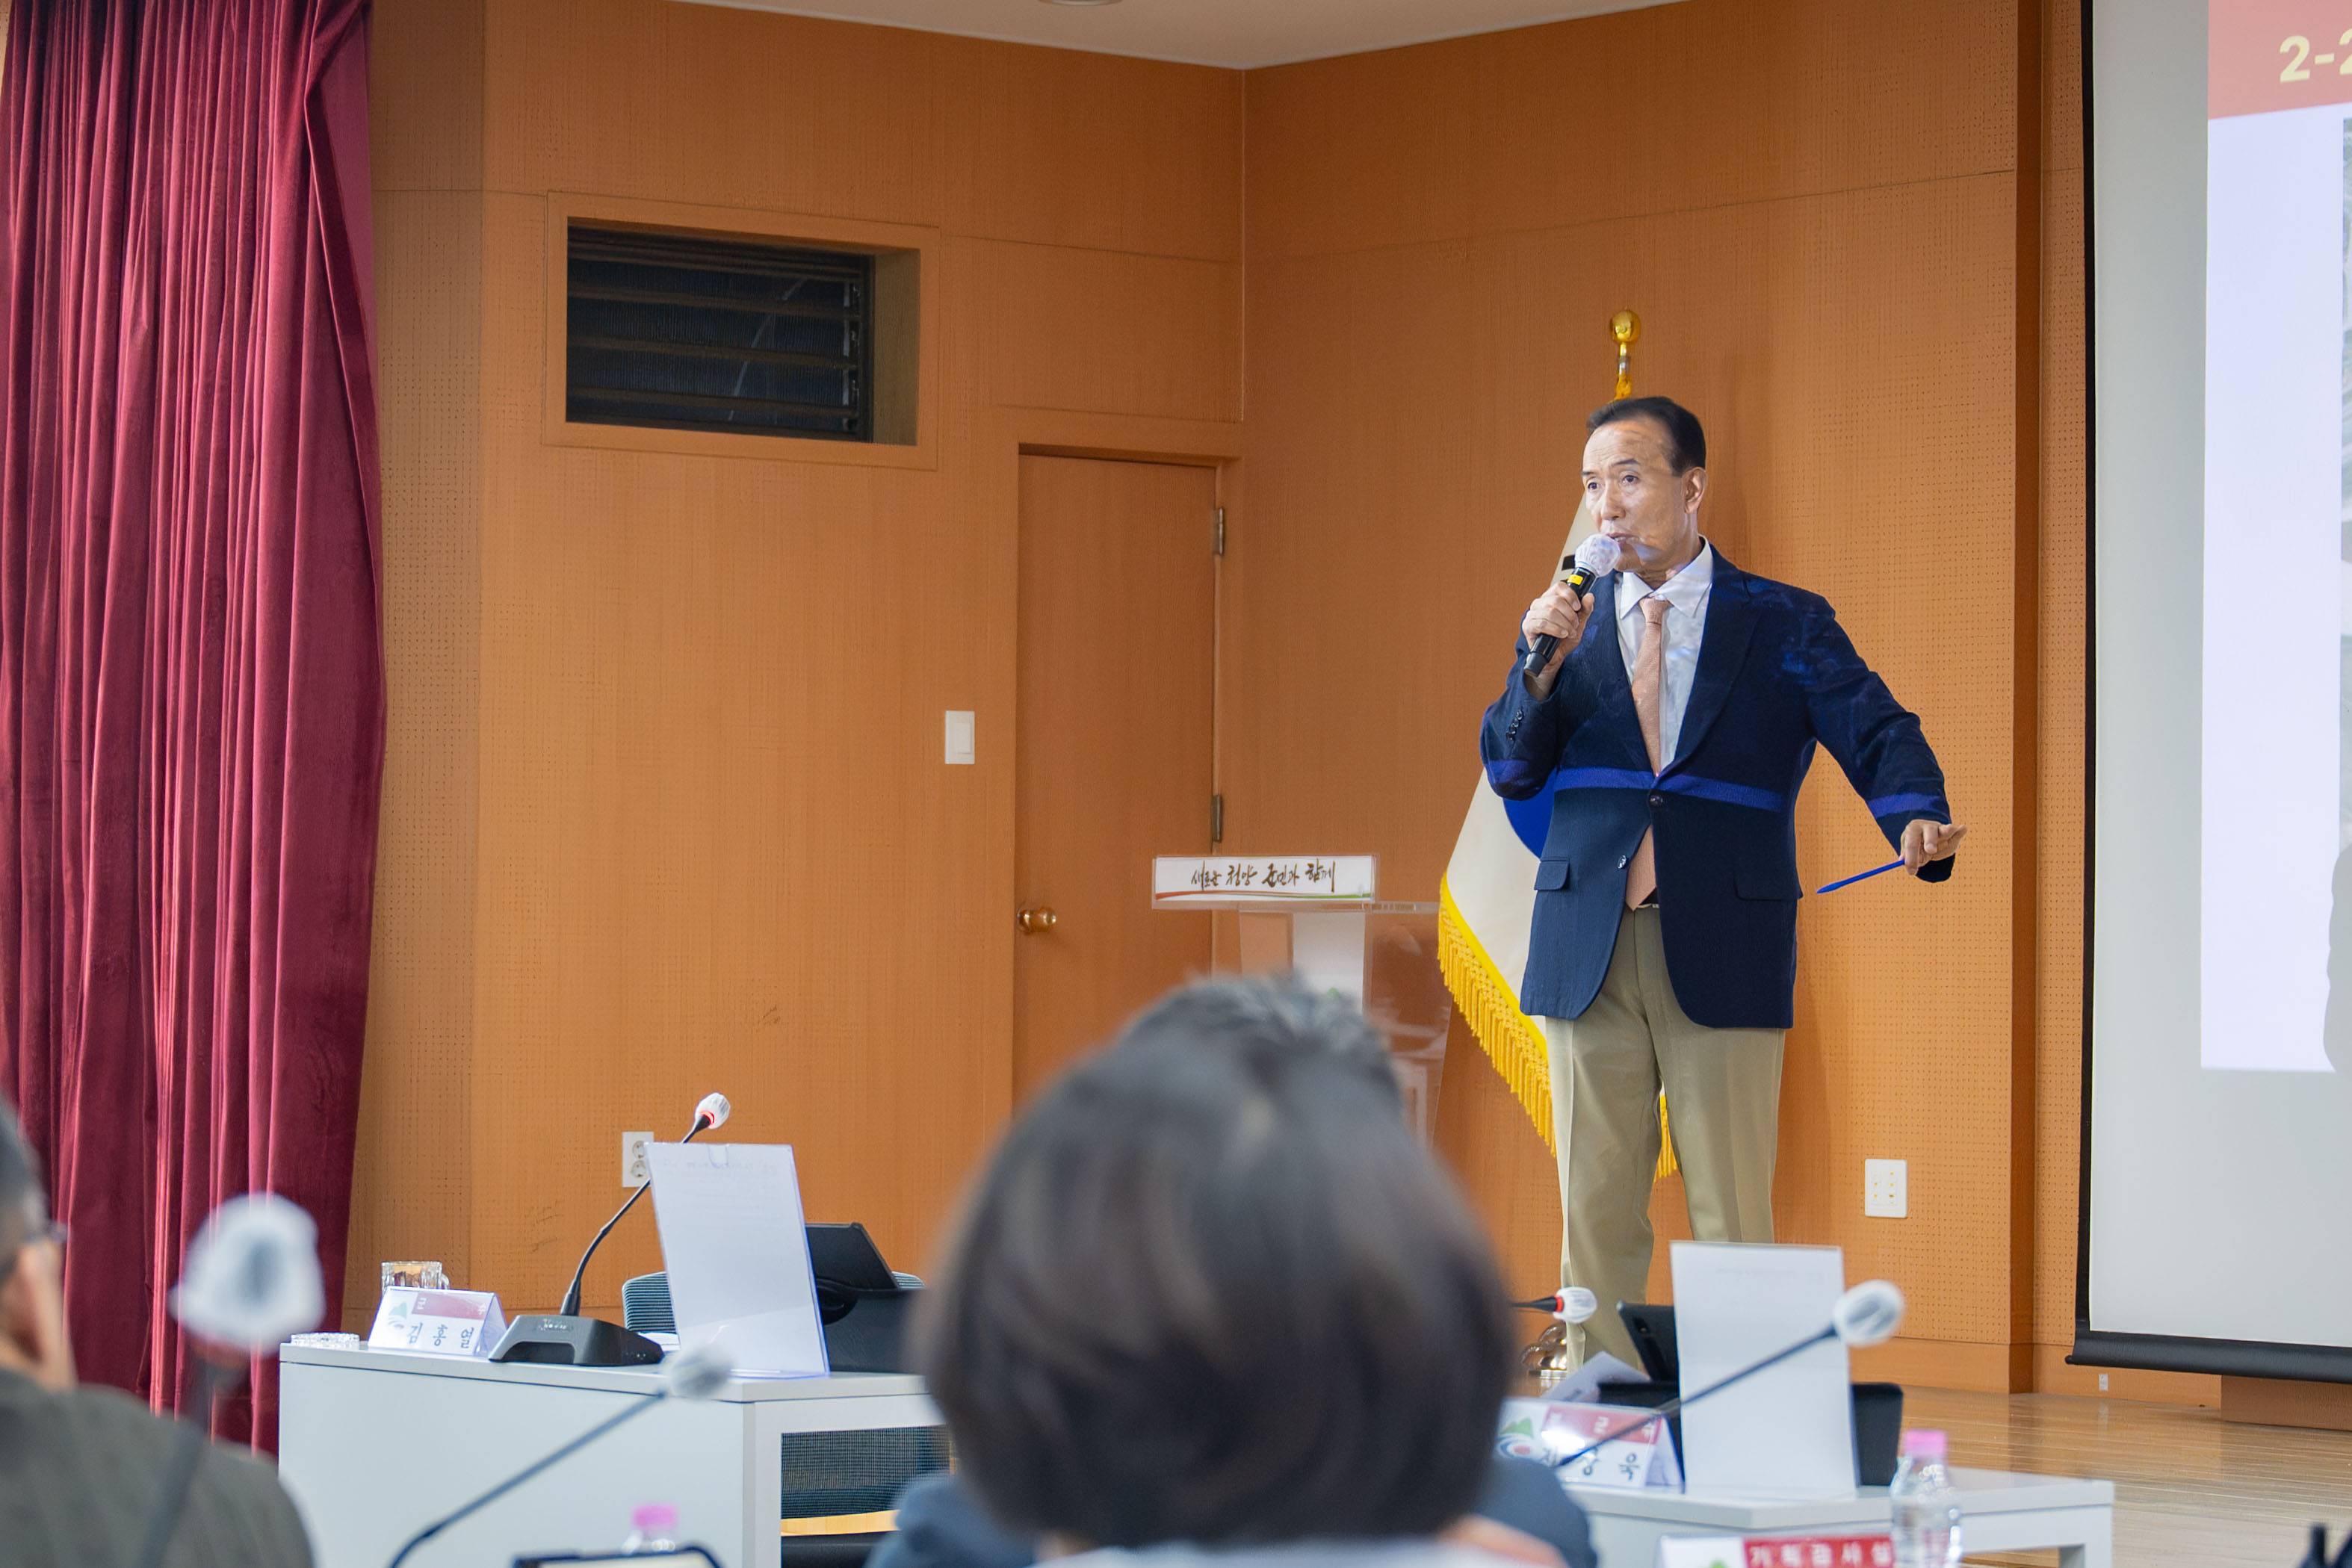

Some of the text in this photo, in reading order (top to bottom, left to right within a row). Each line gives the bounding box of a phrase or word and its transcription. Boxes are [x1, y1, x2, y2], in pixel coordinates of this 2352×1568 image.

[1191, 858, 1335, 893] 새로운 청양 군민과 함께
